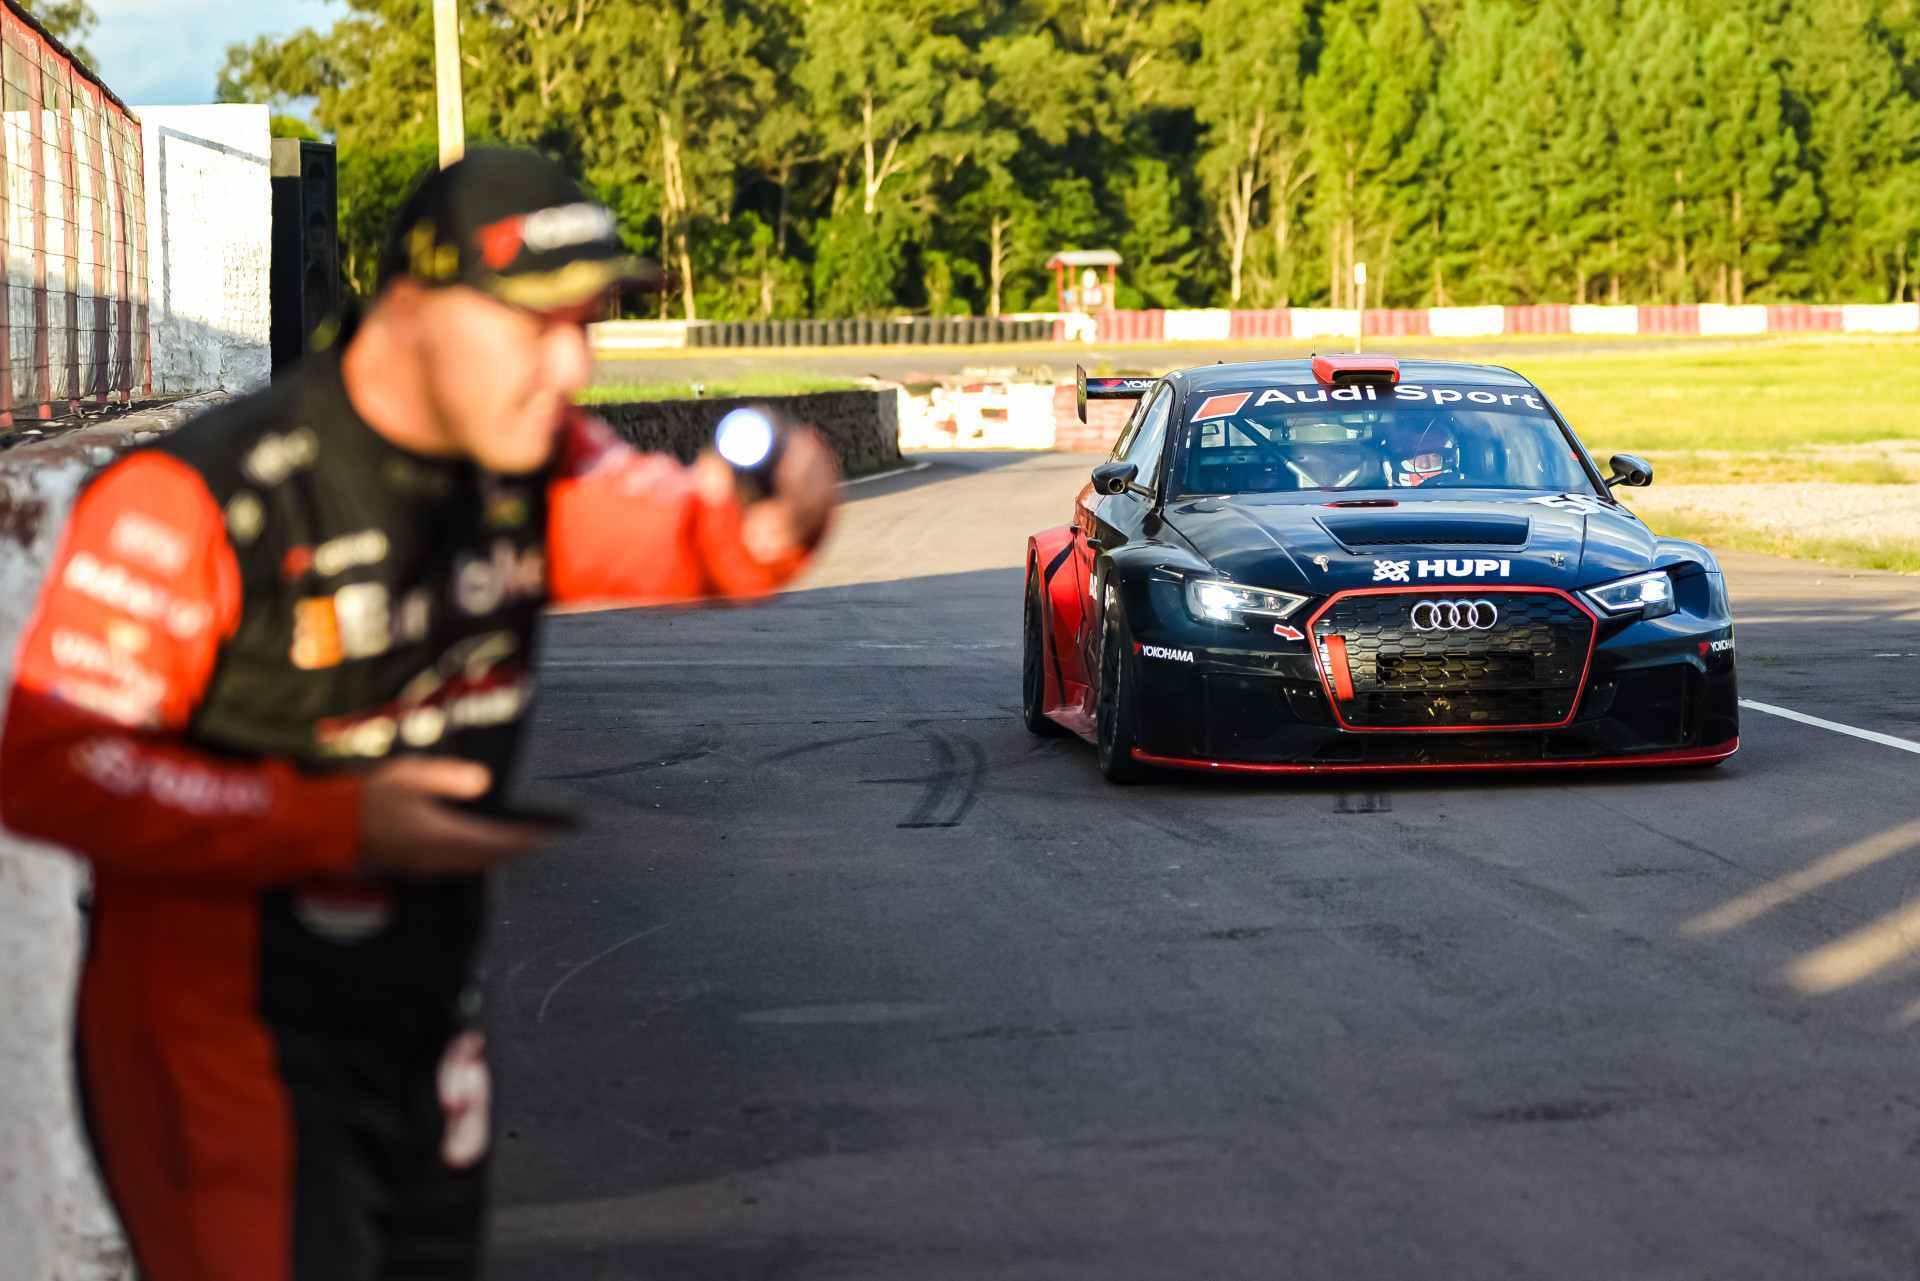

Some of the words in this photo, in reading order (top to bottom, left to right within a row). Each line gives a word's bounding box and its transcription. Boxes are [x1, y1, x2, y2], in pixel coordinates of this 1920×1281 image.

[1255, 384, 1377, 407] Audi
[1393, 384, 1544, 411] Sport
[1417, 559, 1511, 578] HUPI
[1142, 645, 1194, 663] YOKOHAMA
